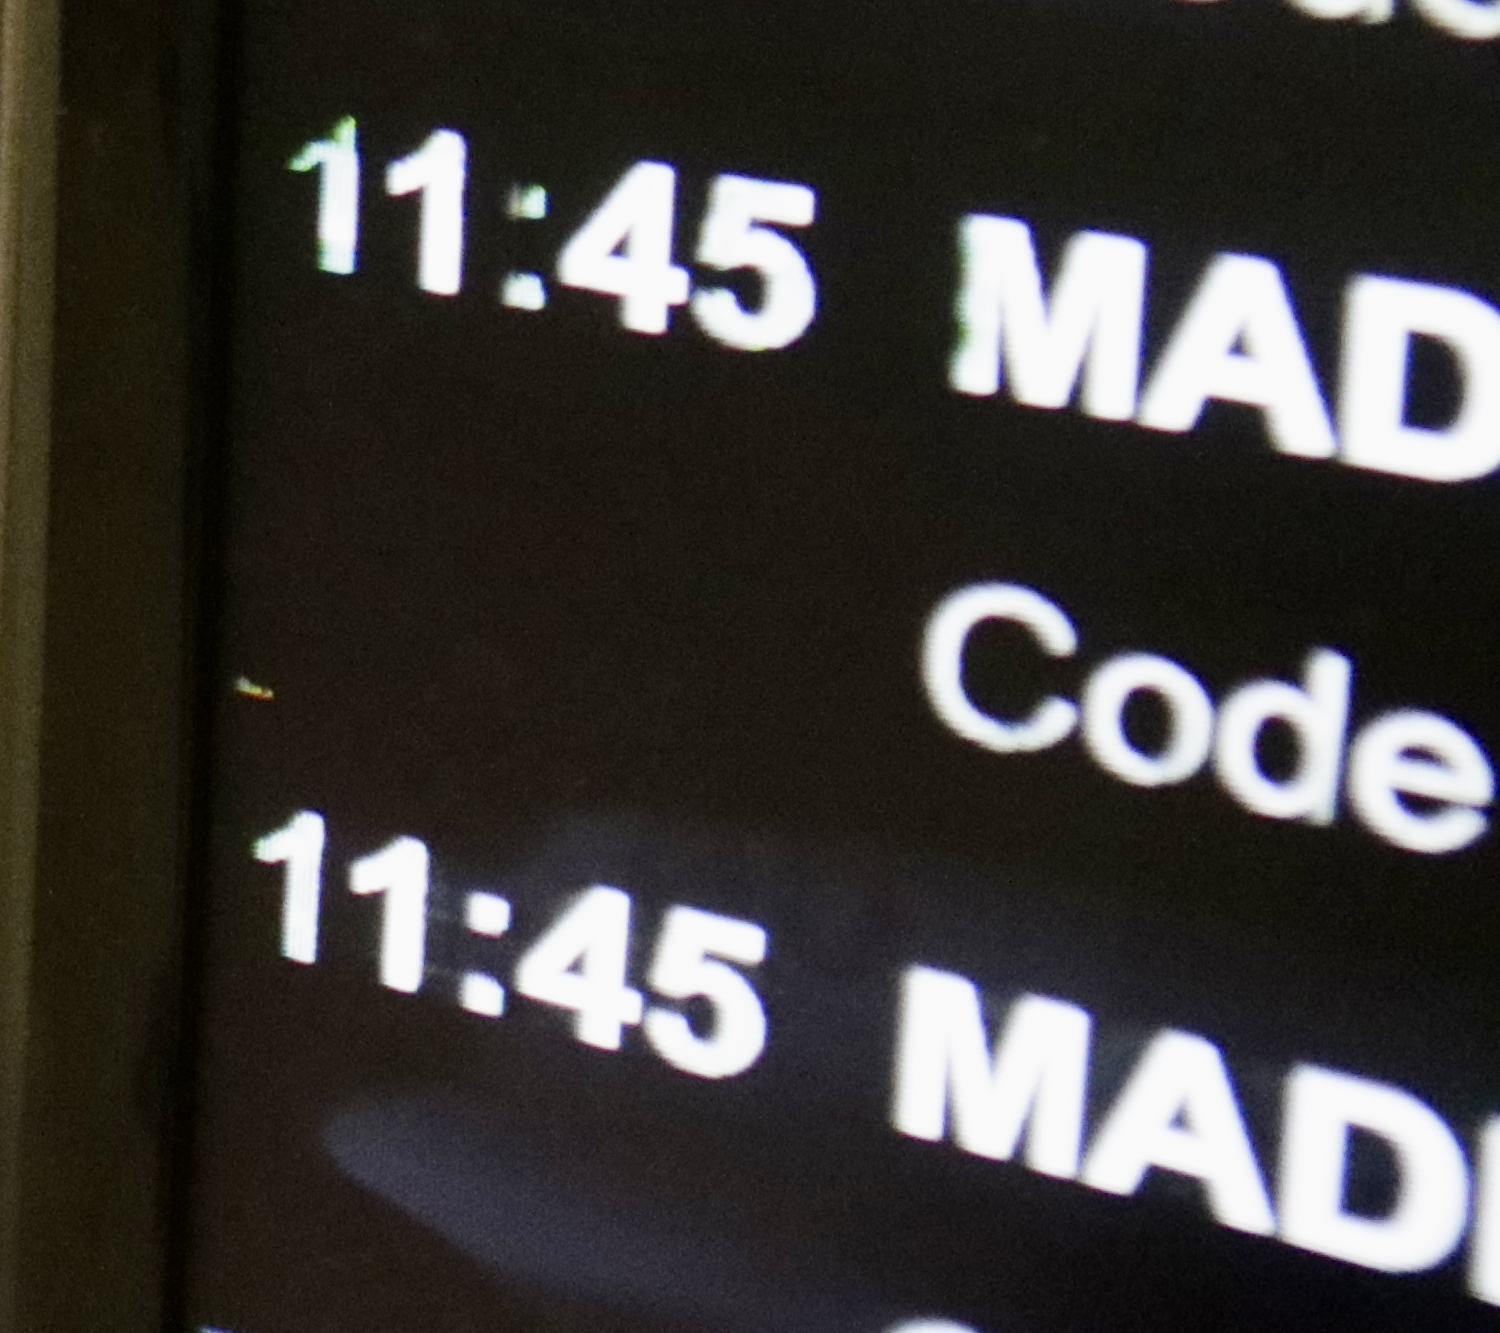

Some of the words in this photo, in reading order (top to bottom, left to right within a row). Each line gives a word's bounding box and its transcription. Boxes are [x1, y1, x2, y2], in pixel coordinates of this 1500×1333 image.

[292, 118, 819, 351] 11:45
[923, 582, 1497, 853] Code
[255, 811, 770, 1079] 11:45
[893, 964, 1500, 1306] MAD
